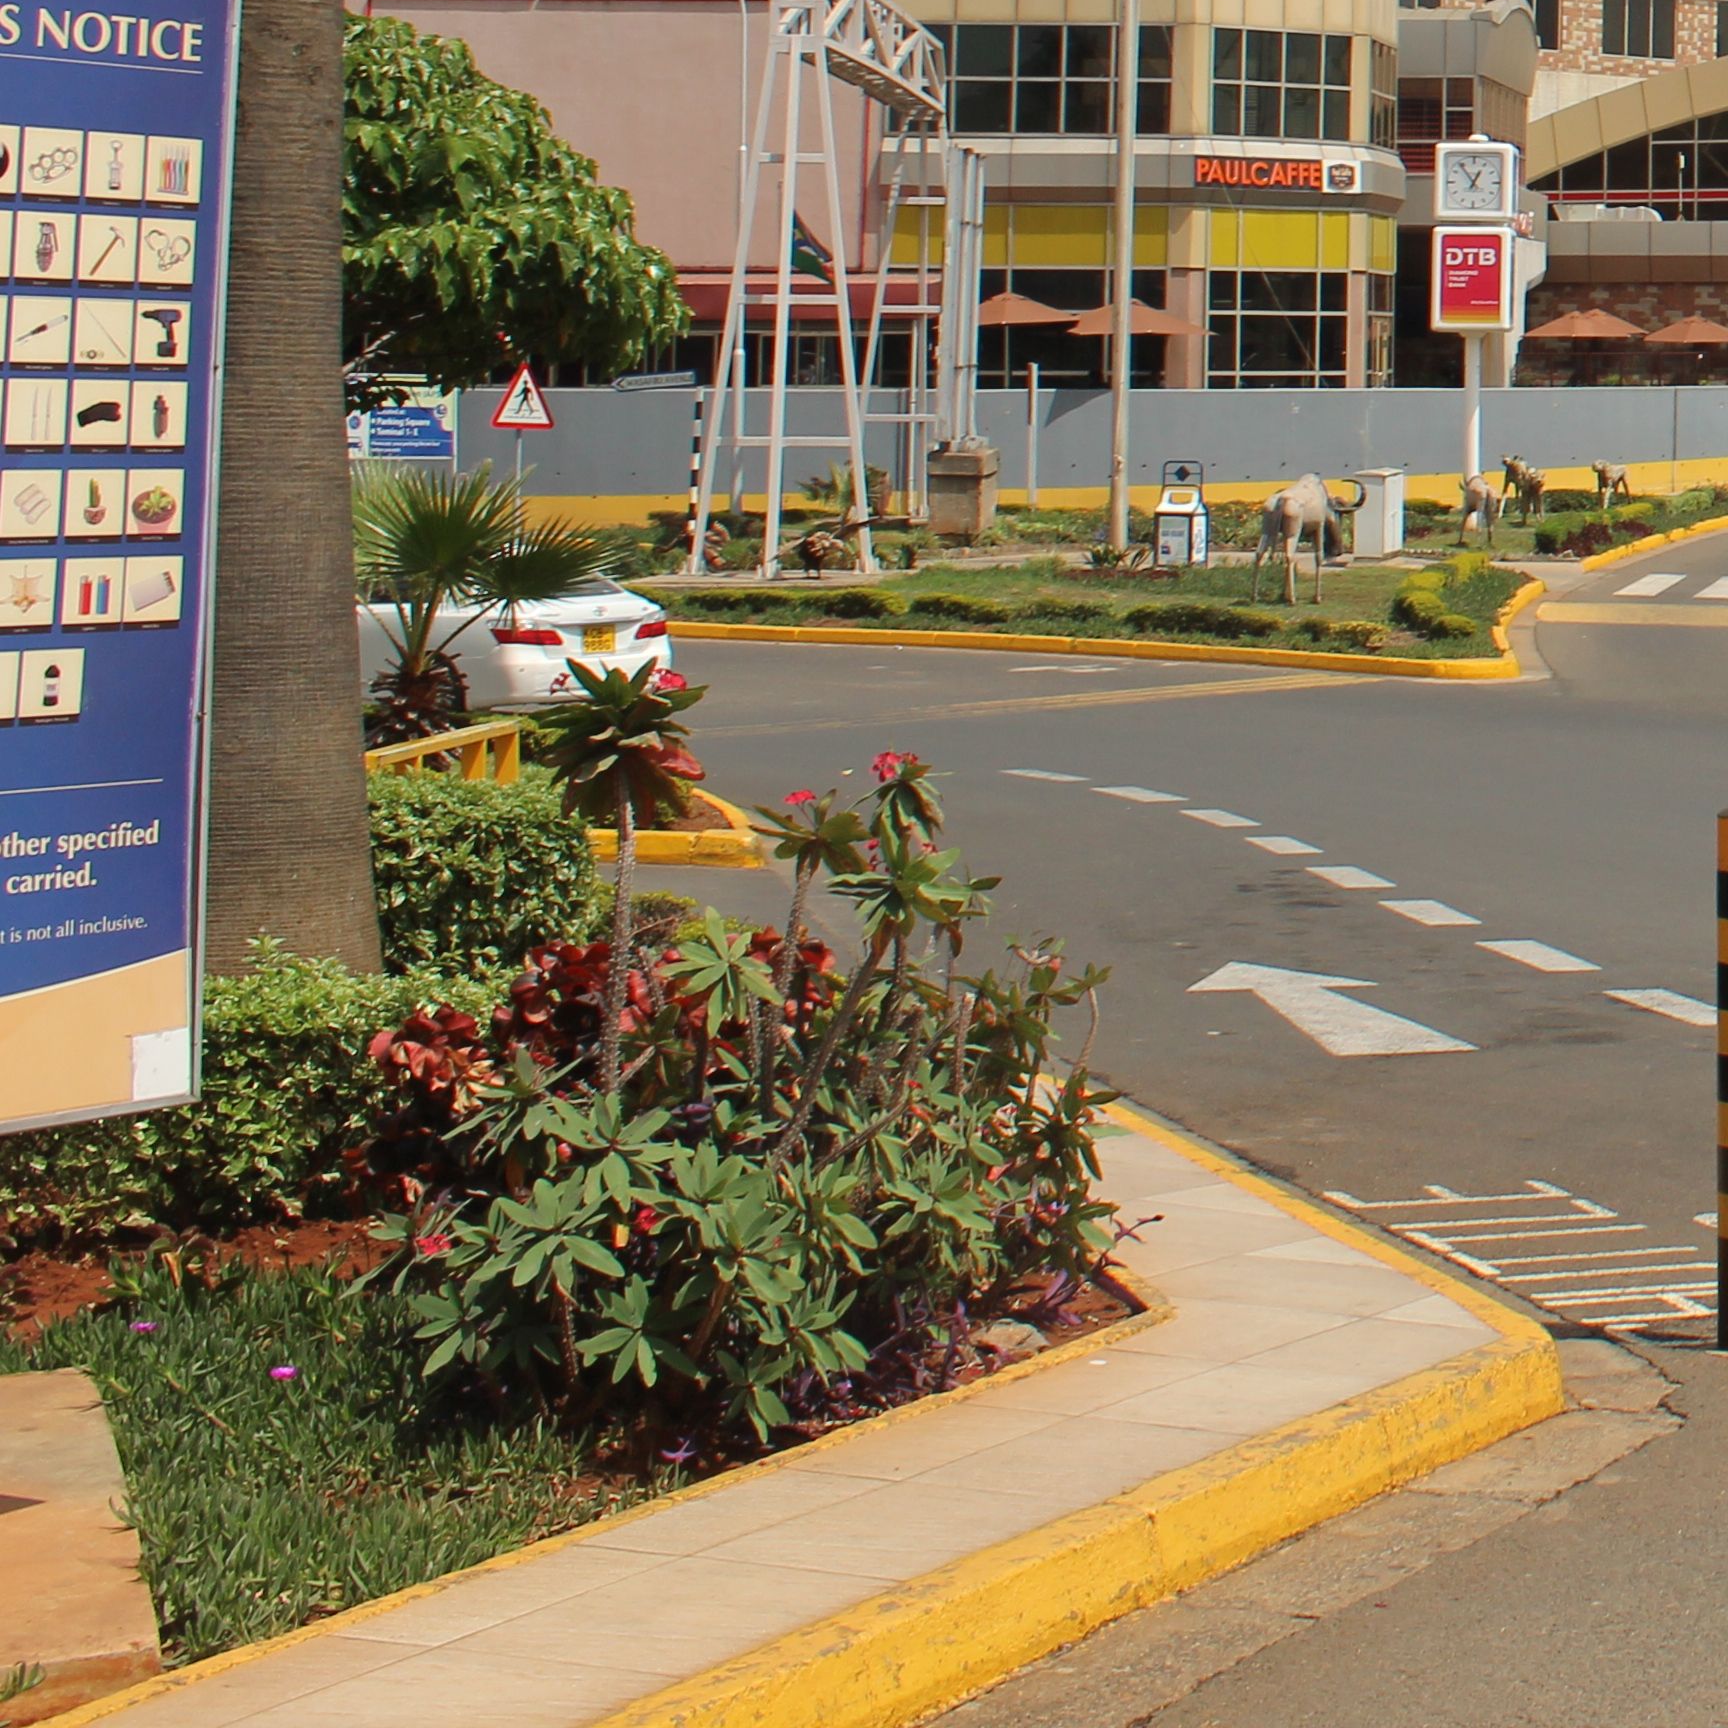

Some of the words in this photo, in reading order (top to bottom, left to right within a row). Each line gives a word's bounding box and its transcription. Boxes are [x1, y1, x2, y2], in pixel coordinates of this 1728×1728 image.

[36, 7, 204, 62] NOTICE
[1445, 247, 1497, 266] DTB
[376, 417, 404, 428] Parking
[404, 417, 431, 428] Square
[0, 831, 51, 859] ther
[57, 819, 160, 859] specified
[5, 860, 98, 895] carried.
[10, 927, 22, 944] is
[26, 925, 51, 941] not
[56, 919, 75, 938] all
[79, 914, 148, 934] inclusive.
